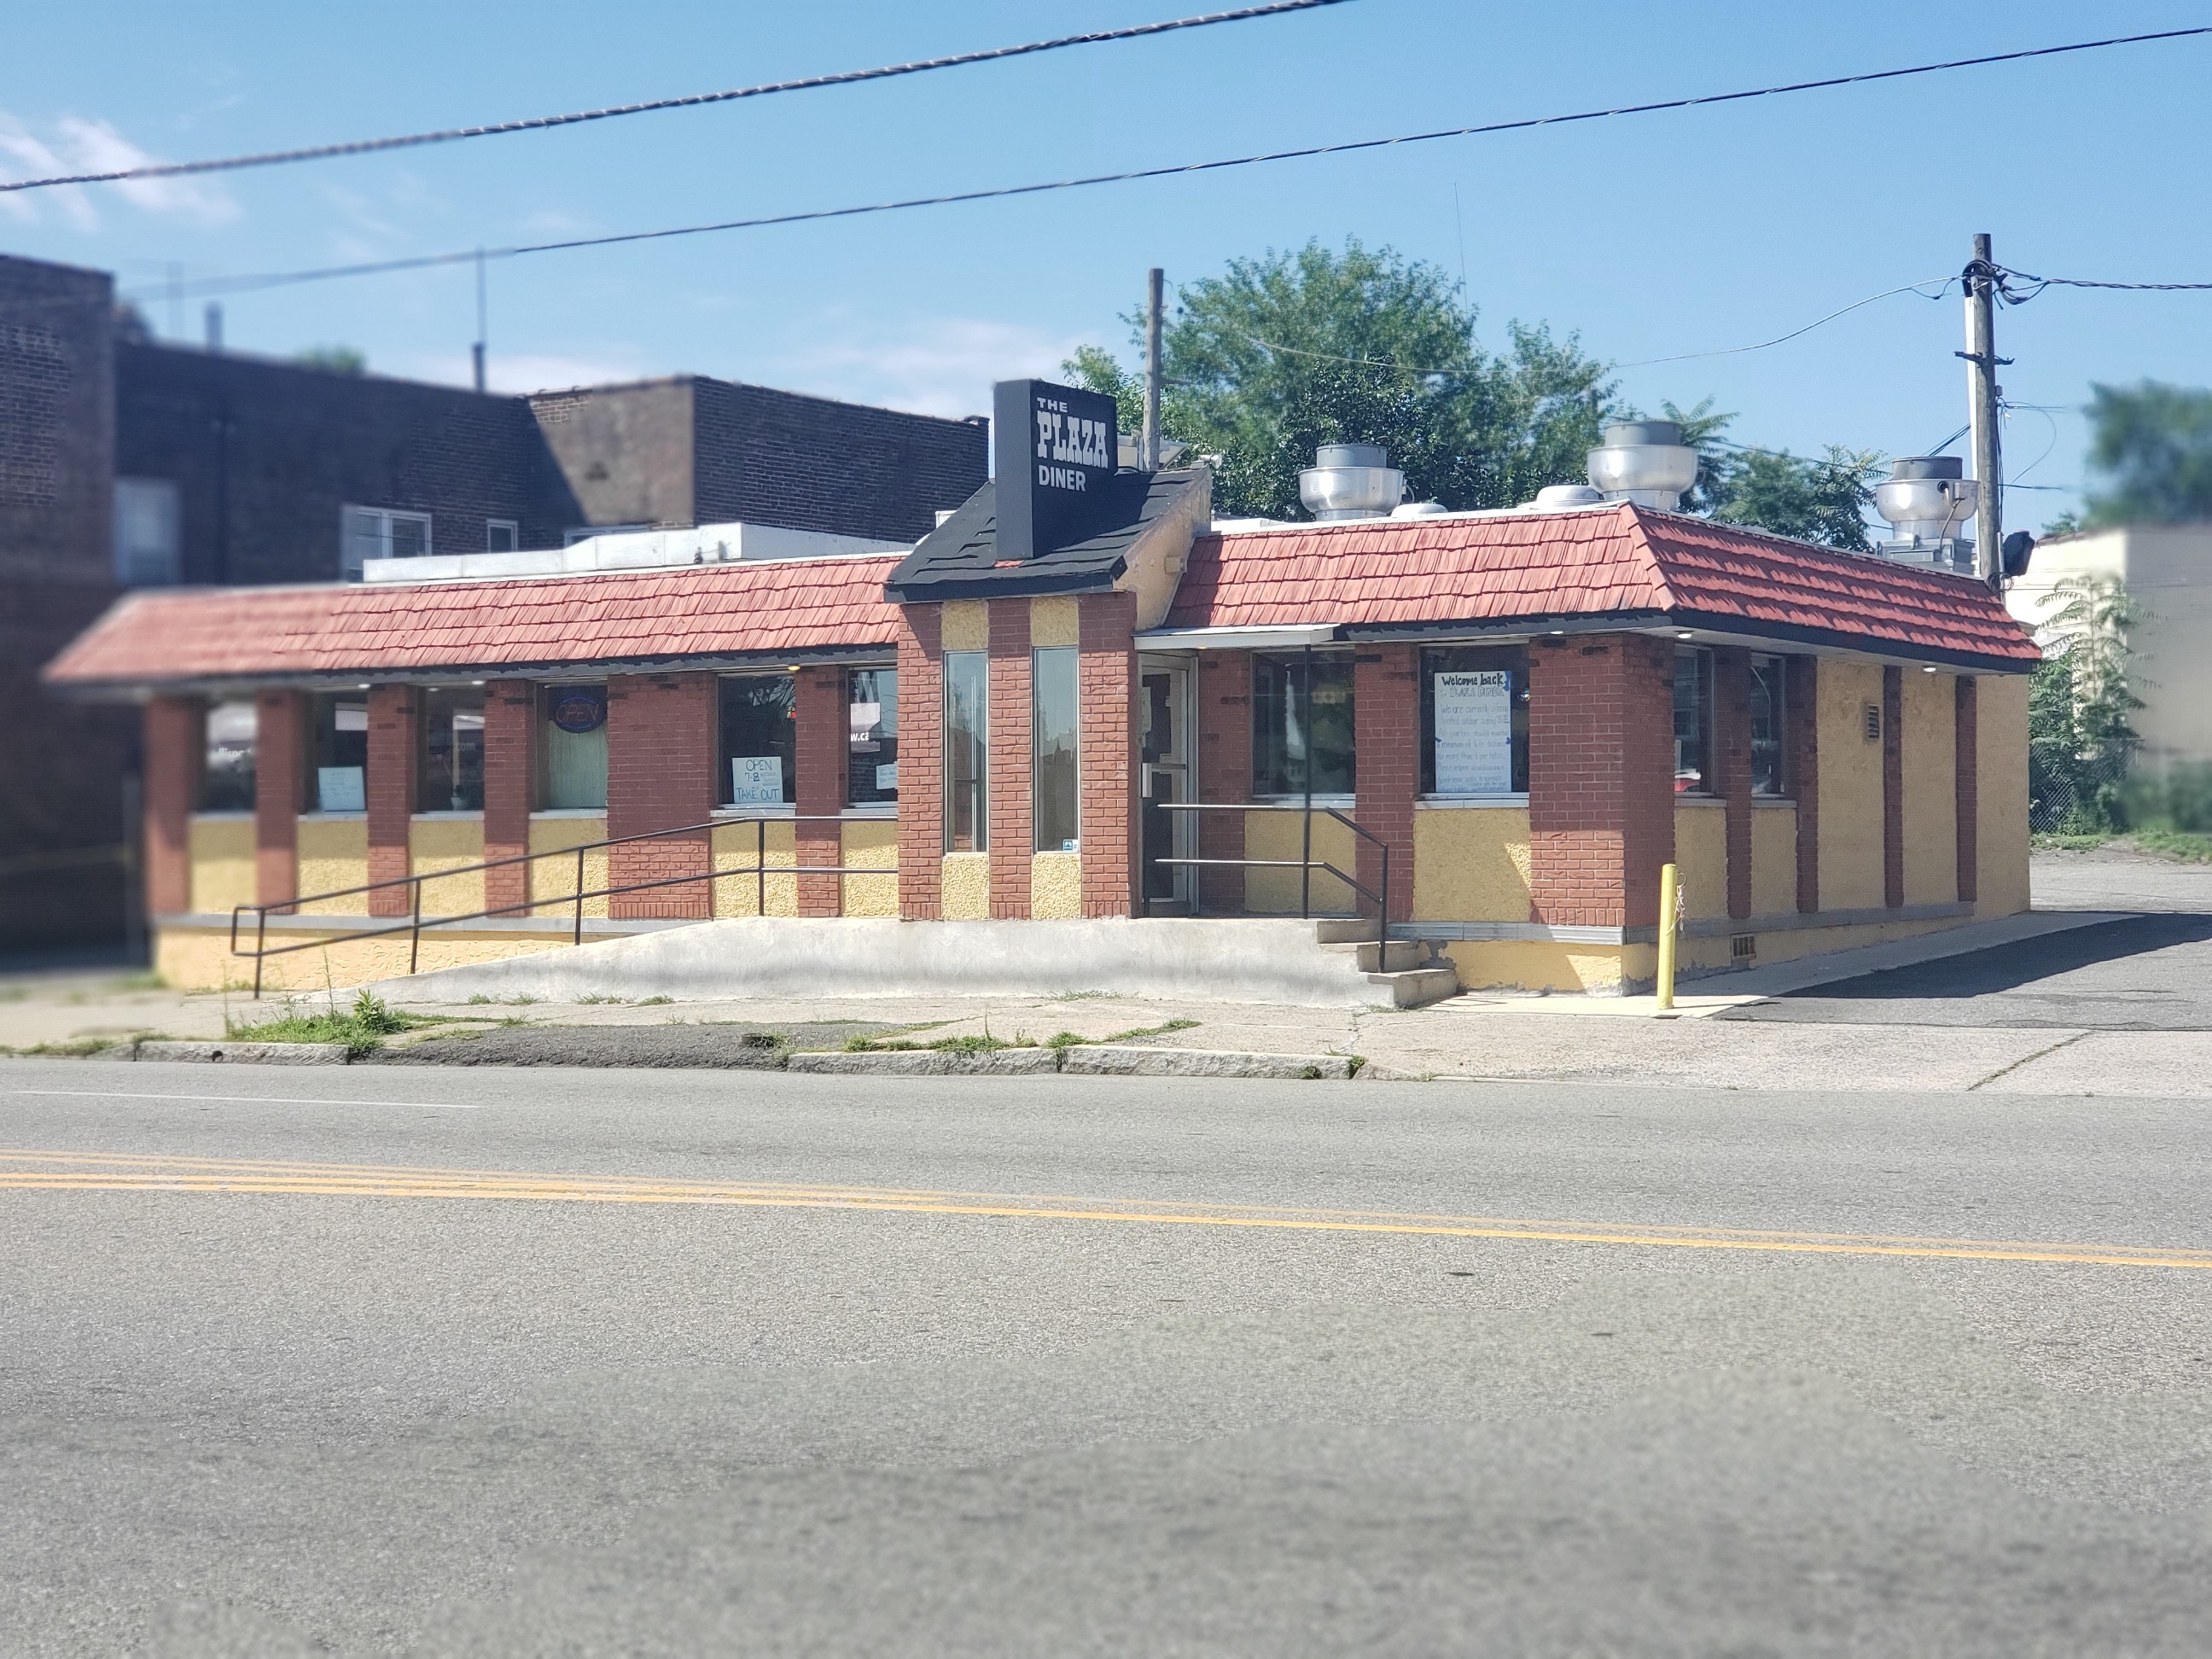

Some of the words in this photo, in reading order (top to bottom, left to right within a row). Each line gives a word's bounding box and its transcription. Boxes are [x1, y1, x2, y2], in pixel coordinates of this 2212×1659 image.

[1037, 397, 1068, 413] THE
[1037, 410, 1109, 469] PLAZA
[1038, 464, 1086, 492] DINER
[1441, 674, 1478, 686] Welcome
[1480, 672, 1505, 685] back
[556, 703, 599, 722] OPEN
[745, 759, 772, 771] OPEN
[735, 787, 758, 800] TAKE
[760, 788, 780, 800] OUT
